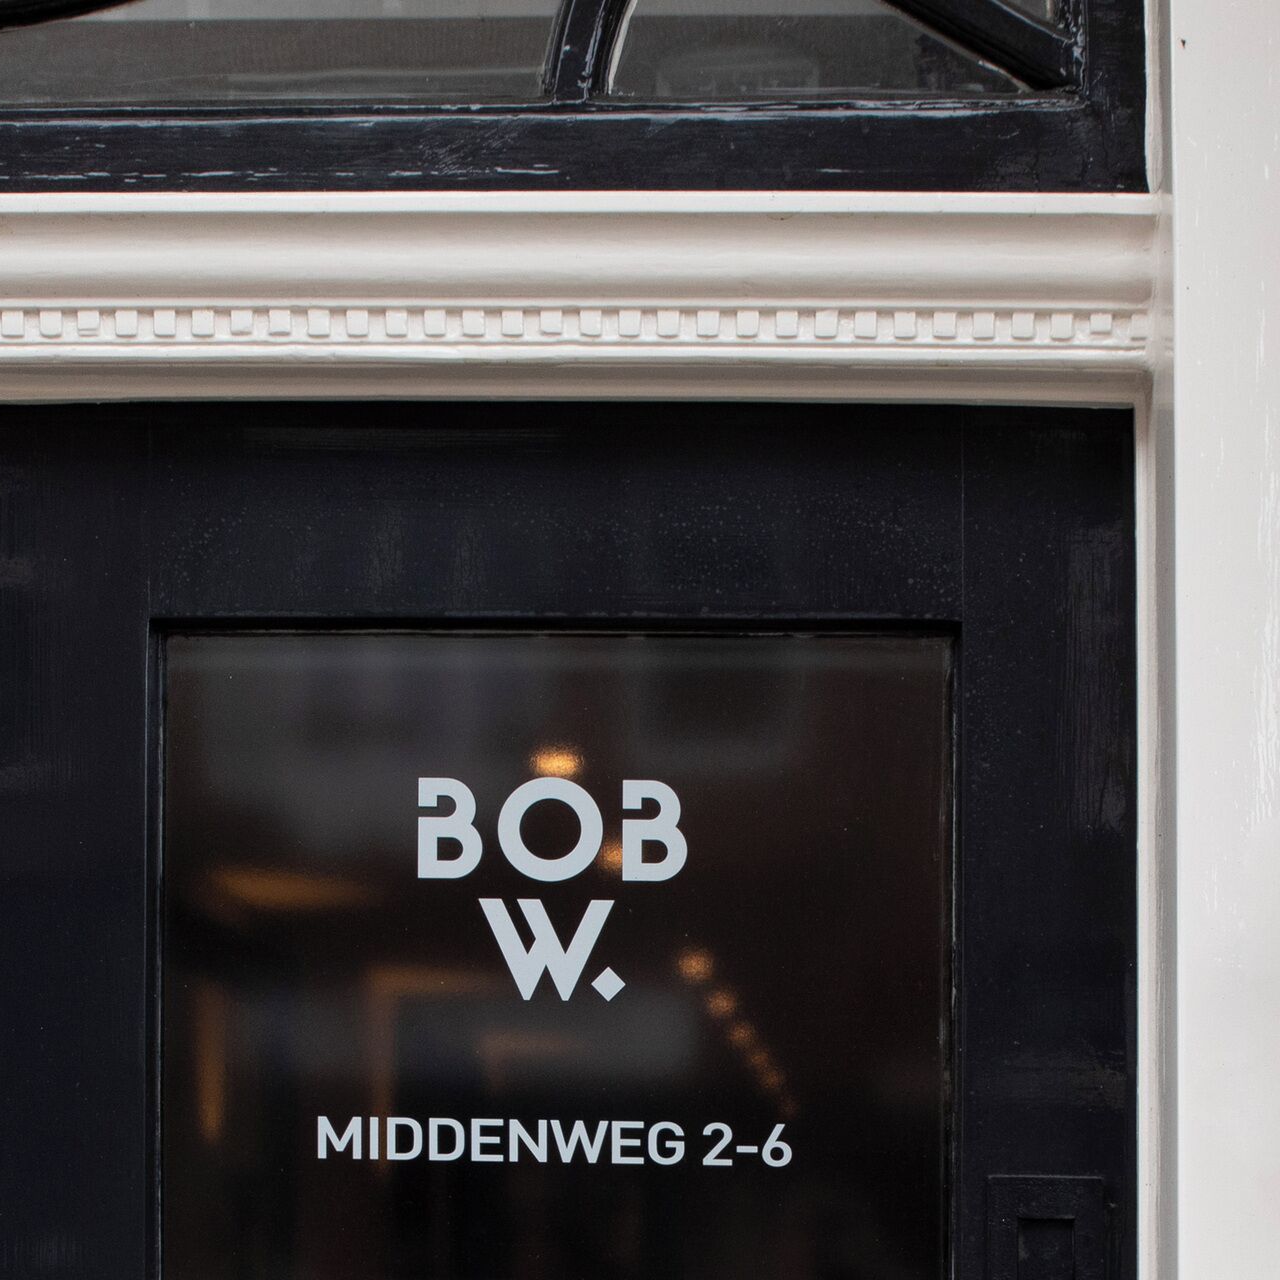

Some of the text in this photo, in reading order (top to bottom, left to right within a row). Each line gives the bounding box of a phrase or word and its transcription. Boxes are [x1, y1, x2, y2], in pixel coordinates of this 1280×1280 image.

[416, 775, 689, 883] BOB
[477, 897, 627, 1003] W.
[316, 1114, 794, 1168] MIDDENWEG 2-6
